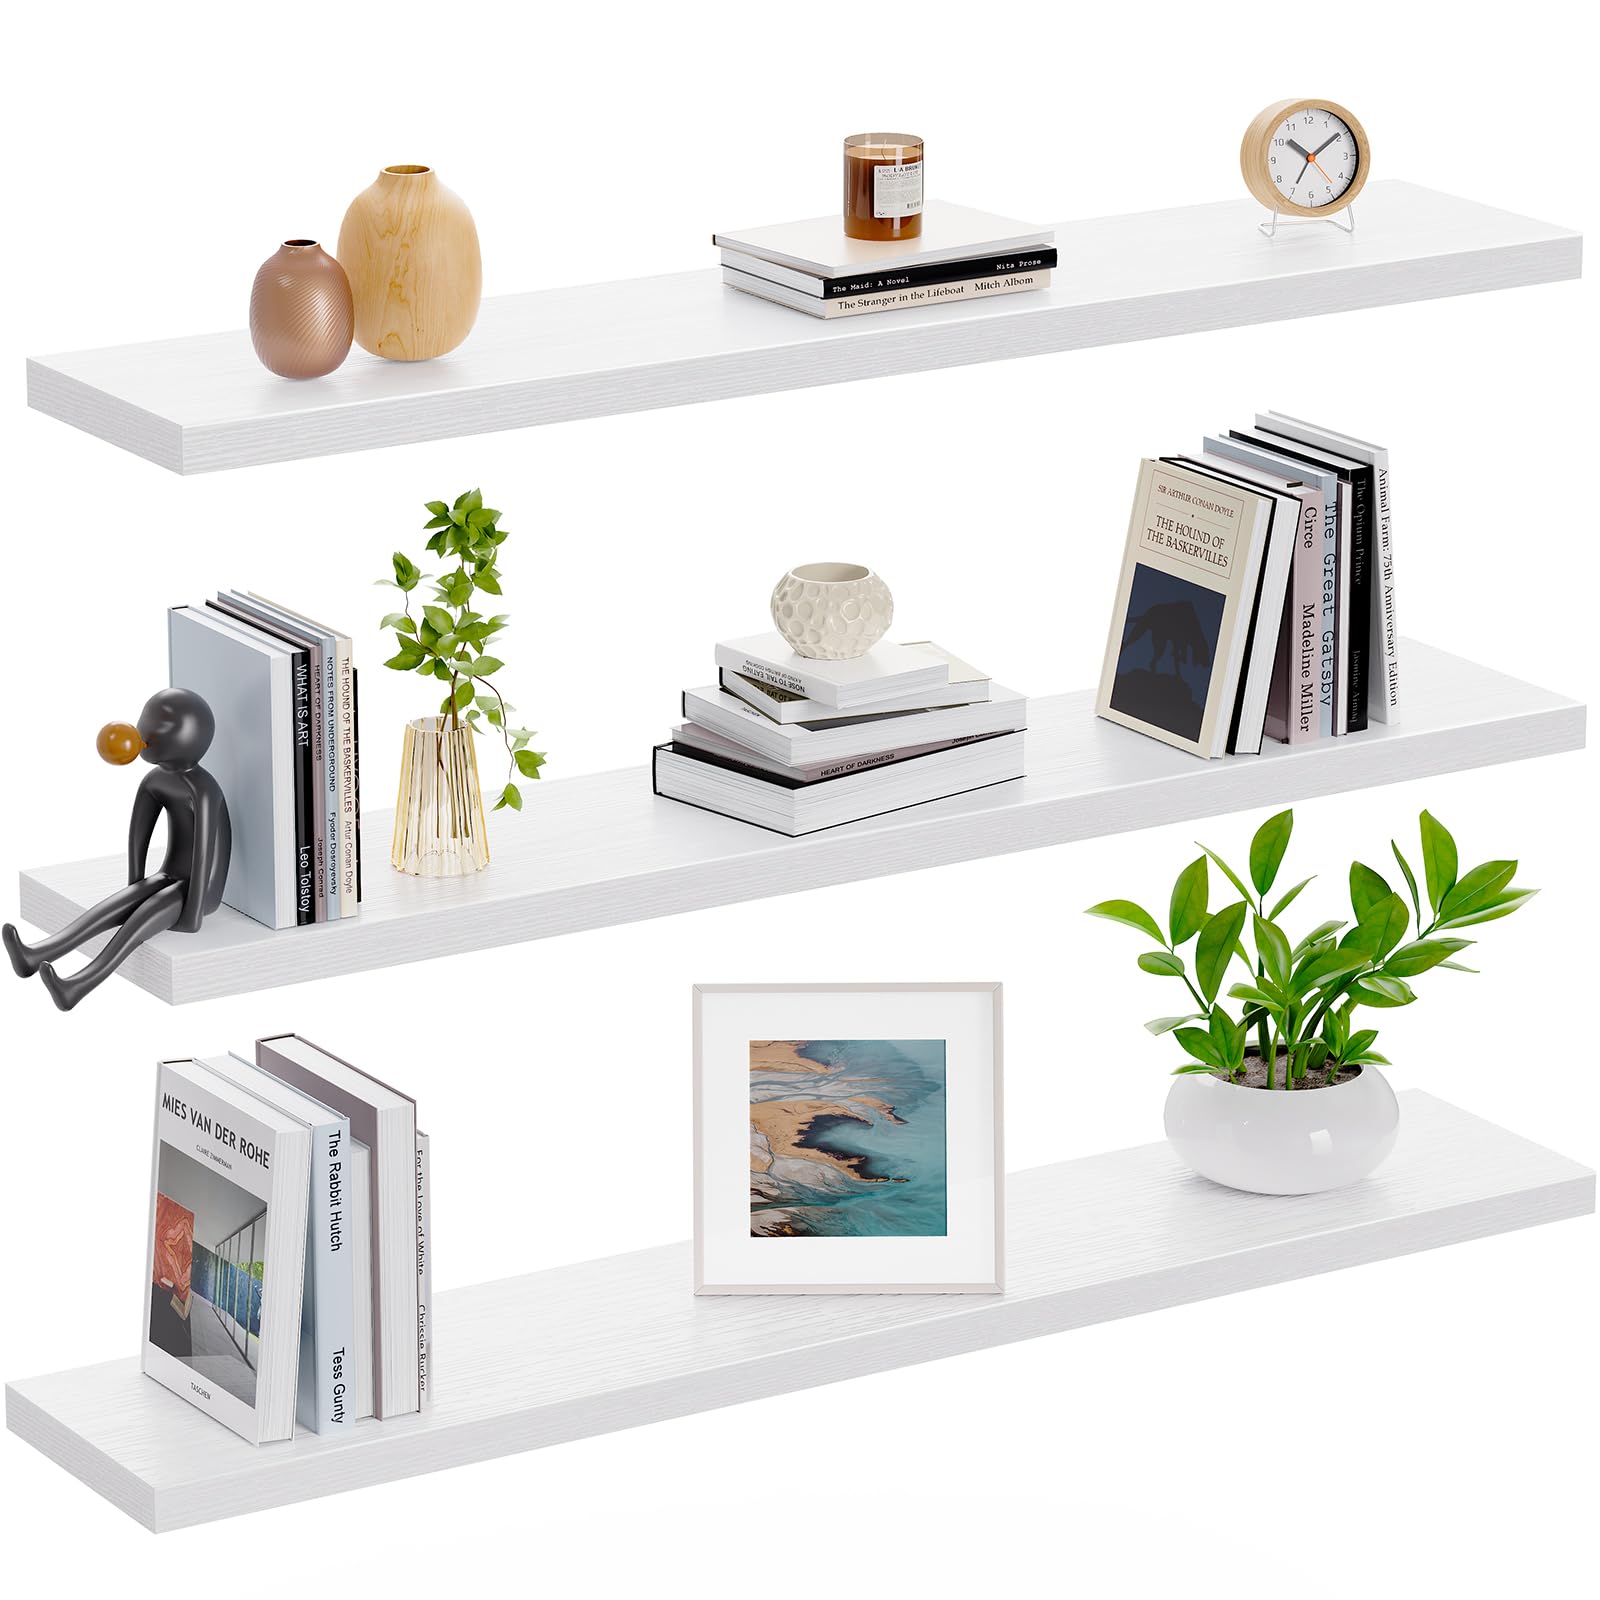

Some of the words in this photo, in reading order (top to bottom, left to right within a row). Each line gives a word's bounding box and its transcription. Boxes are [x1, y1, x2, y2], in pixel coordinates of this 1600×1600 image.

[1274, 138, 1284, 146] 10
[1276, 175, 1282, 183] 8
[1290, 187, 1295, 195] 7
[996, 262, 1015, 271] Nita
[1019, 258, 1042, 268] Prose
[850, 282, 873, 291] Maid:
[886, 276, 910, 286] Novel
[974, 280, 1001, 292] Mitch
[1003, 276, 1033, 288] Albom
[837, 300, 856, 311] The
[857, 296, 897, 308] Stranger
[899, 294, 908, 302] in
[910, 291, 925, 301] the
[927, 285, 964, 298] Lifeboat
[1157, 484, 1167, 494] SIR
[1167, 488, 1191, 503] ARTHUR
[1192, 496, 1215, 511] CONAN
[1214, 504, 1234, 518] DOYLE
[1357, 478, 1367, 500] The
[1379, 468, 1389, 513] Animal
[1156, 515, 1174, 532] THE
[1175, 522, 1210, 545] HOUND
[1211, 535, 1225, 550] OF
[1303, 506, 1317, 549] Circe
[1324, 501, 1337, 539] The
[1353, 503, 1365, 544] Opium
[1381, 516, 1390, 552] Farm:
[1146, 528, 1164, 545] THE
[1165, 535, 1228, 568] BASKERVILLES
[1355, 548, 1364, 585] Prince
[1383, 553, 1393, 580] 75th
[1322, 553, 1336, 617] Great
[1385, 585, 1395, 658] Anniversary
[1301, 603, 1315, 678] Madeline
[342, 657, 350, 675] THE
[742, 665, 764, 679] EATING
[766, 673, 778, 683] TAIL
[1320, 630, 1334, 706] Gatsby
[296, 663, 308, 702] WHAT
[342, 677, 350, 710] HOUND
[779, 678, 787, 687] TO
[788, 683, 805, 693] NOSE
[1388, 661, 1398, 706] Edition
[297, 706, 308, 719] IS
[314, 697, 321, 712] OF
[1300, 682, 1313, 732] Miller
[342, 712, 351, 726] OF
[297, 722, 308, 747] ART
[343, 727, 351, 745] THE
[820, 765, 844, 777] HEART
[845, 762, 856, 771] OF
[857, 753, 895, 768] DARKNESS
[343, 747, 352, 813] BASKERVILLES
[328, 812, 336, 841] Fyodor
[300, 846, 311, 868] Leo
[345, 842, 353, 868] Conan
[298, 871, 312, 913] Tolstoy
[344, 870, 353, 894] Doyle
[162, 1092, 187, 1120] MIES
[190, 1107, 212, 1135] VAN
[214, 1122, 237, 1150] DER
[239, 1137, 270, 1169] ROHE
[328, 1130, 341, 1158] The
[328, 1162, 342, 1208] Rabbit
[330, 1211, 343, 1252] Hutch
[417, 1226, 424, 1238] of
[332, 1347, 345, 1380] Tess
[190, 1382, 211, 1400] TASCHEN
[331, 1383, 346, 1424] Gunty
